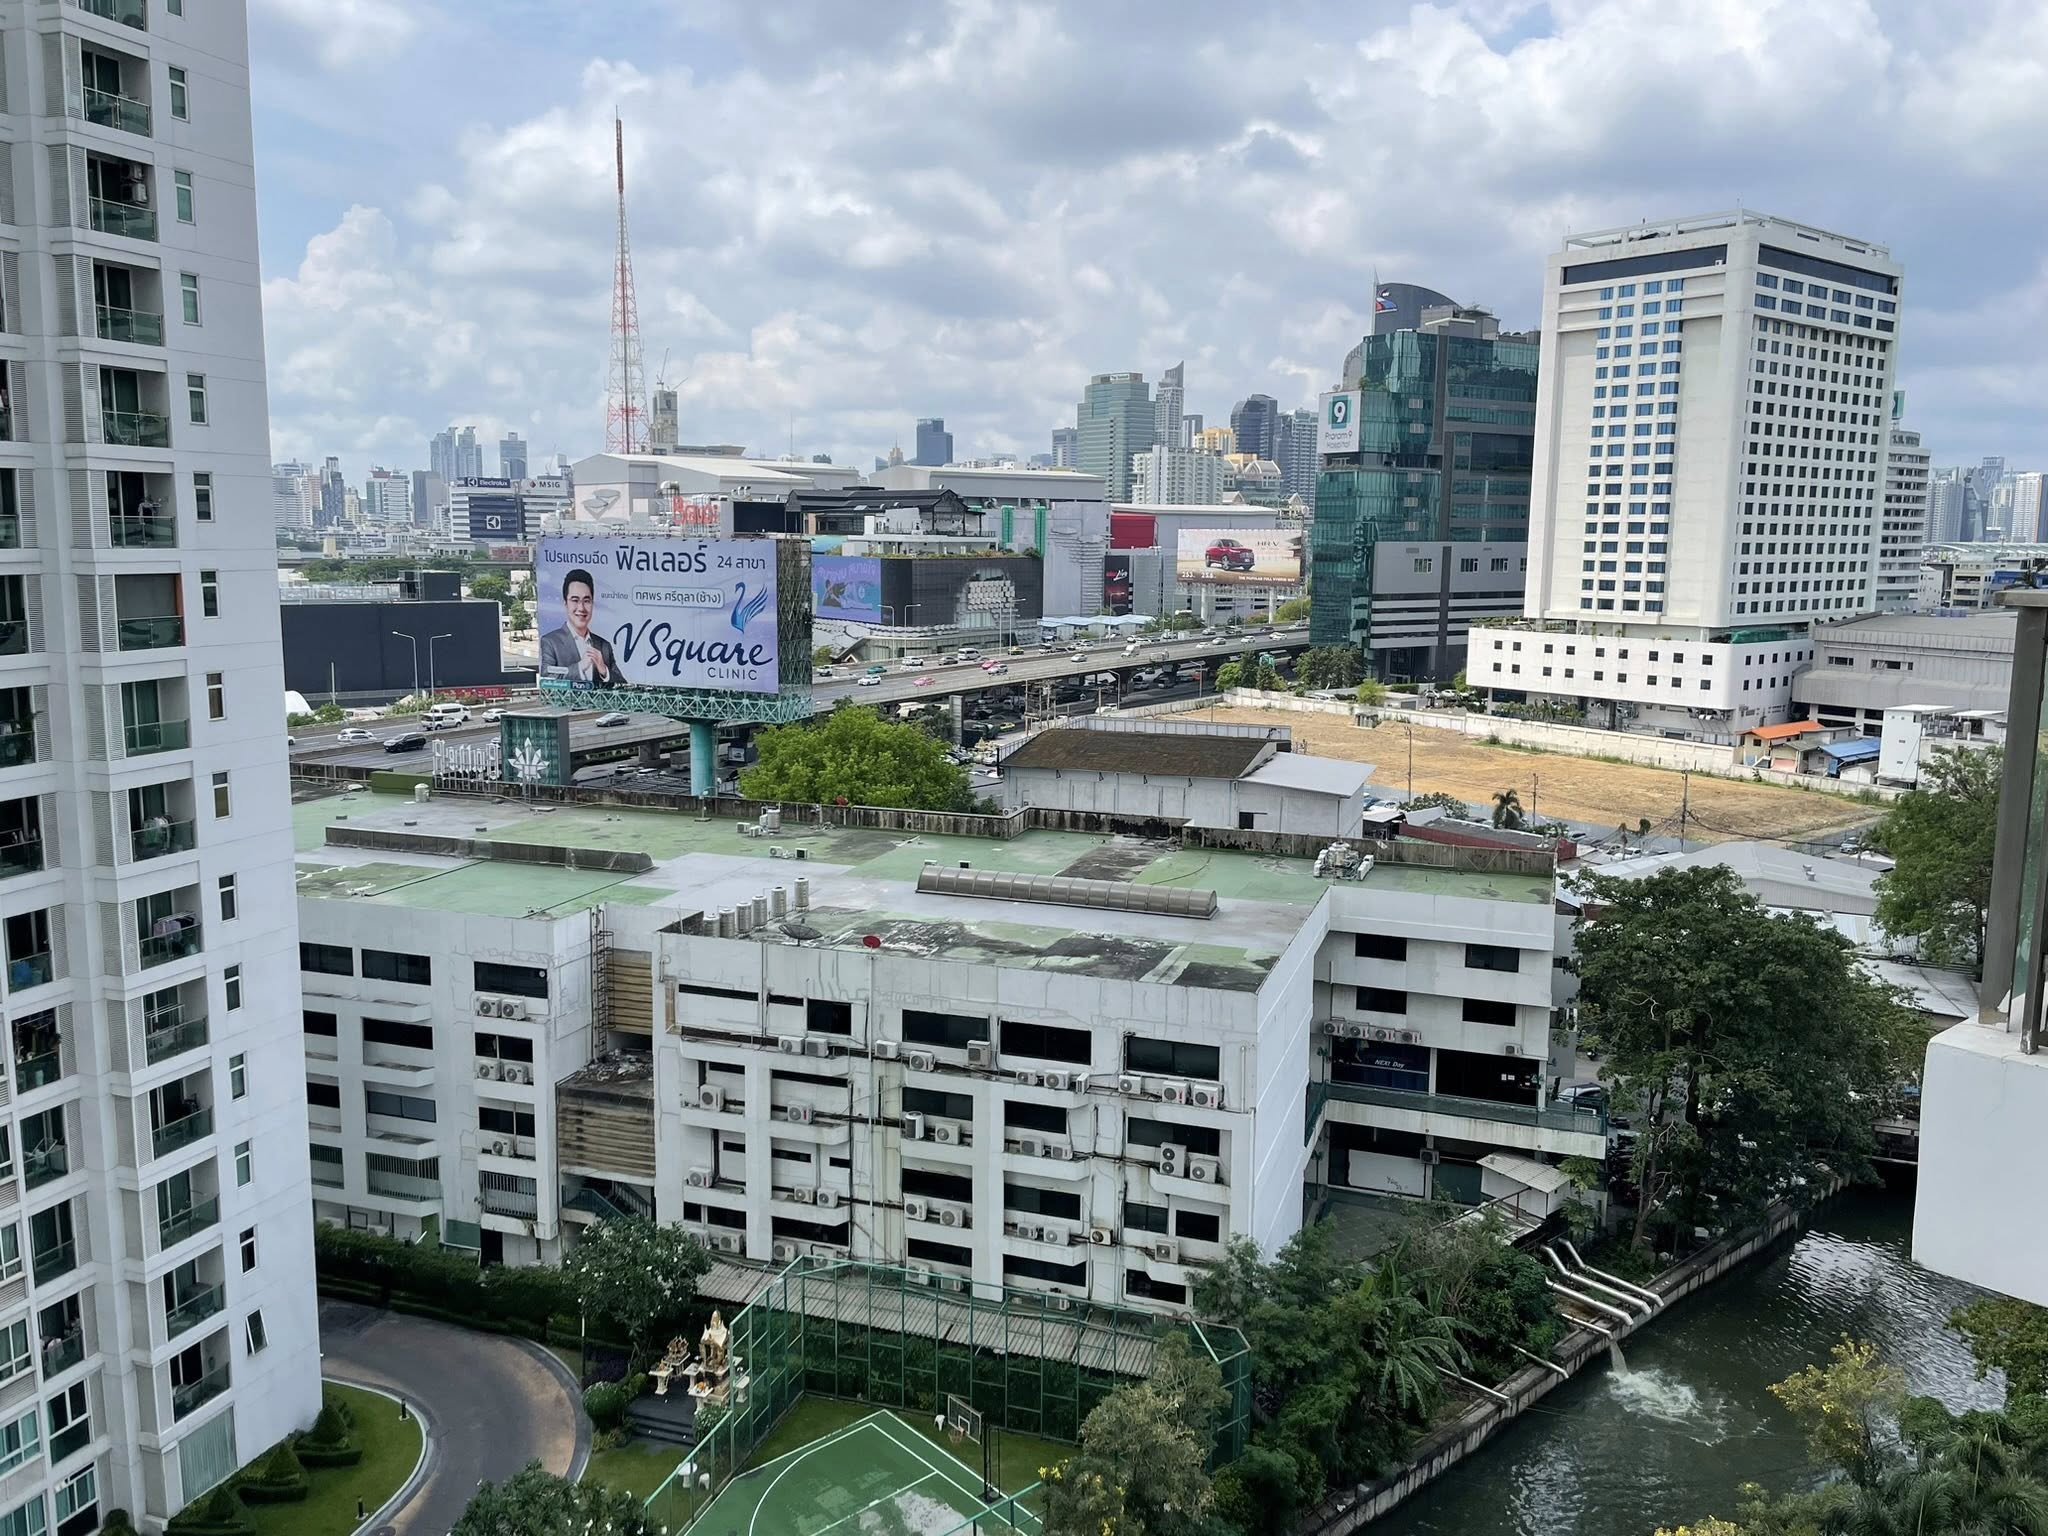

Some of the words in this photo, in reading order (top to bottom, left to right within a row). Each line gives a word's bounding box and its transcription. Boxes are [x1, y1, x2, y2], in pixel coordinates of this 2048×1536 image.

[1334, 401, 1346, 423] 9
[479, 479, 508, 487] Electrolux
[544, 550, 608, 565] โปรแกรมฉีด
[615, 545, 707, 573] ฟิลเลอร์
[717, 555, 732, 568] 24
[735, 557, 766, 570] สาขา
[635, 591, 662, 601] ทศพร
[707, 667, 758, 681] CLINIC
